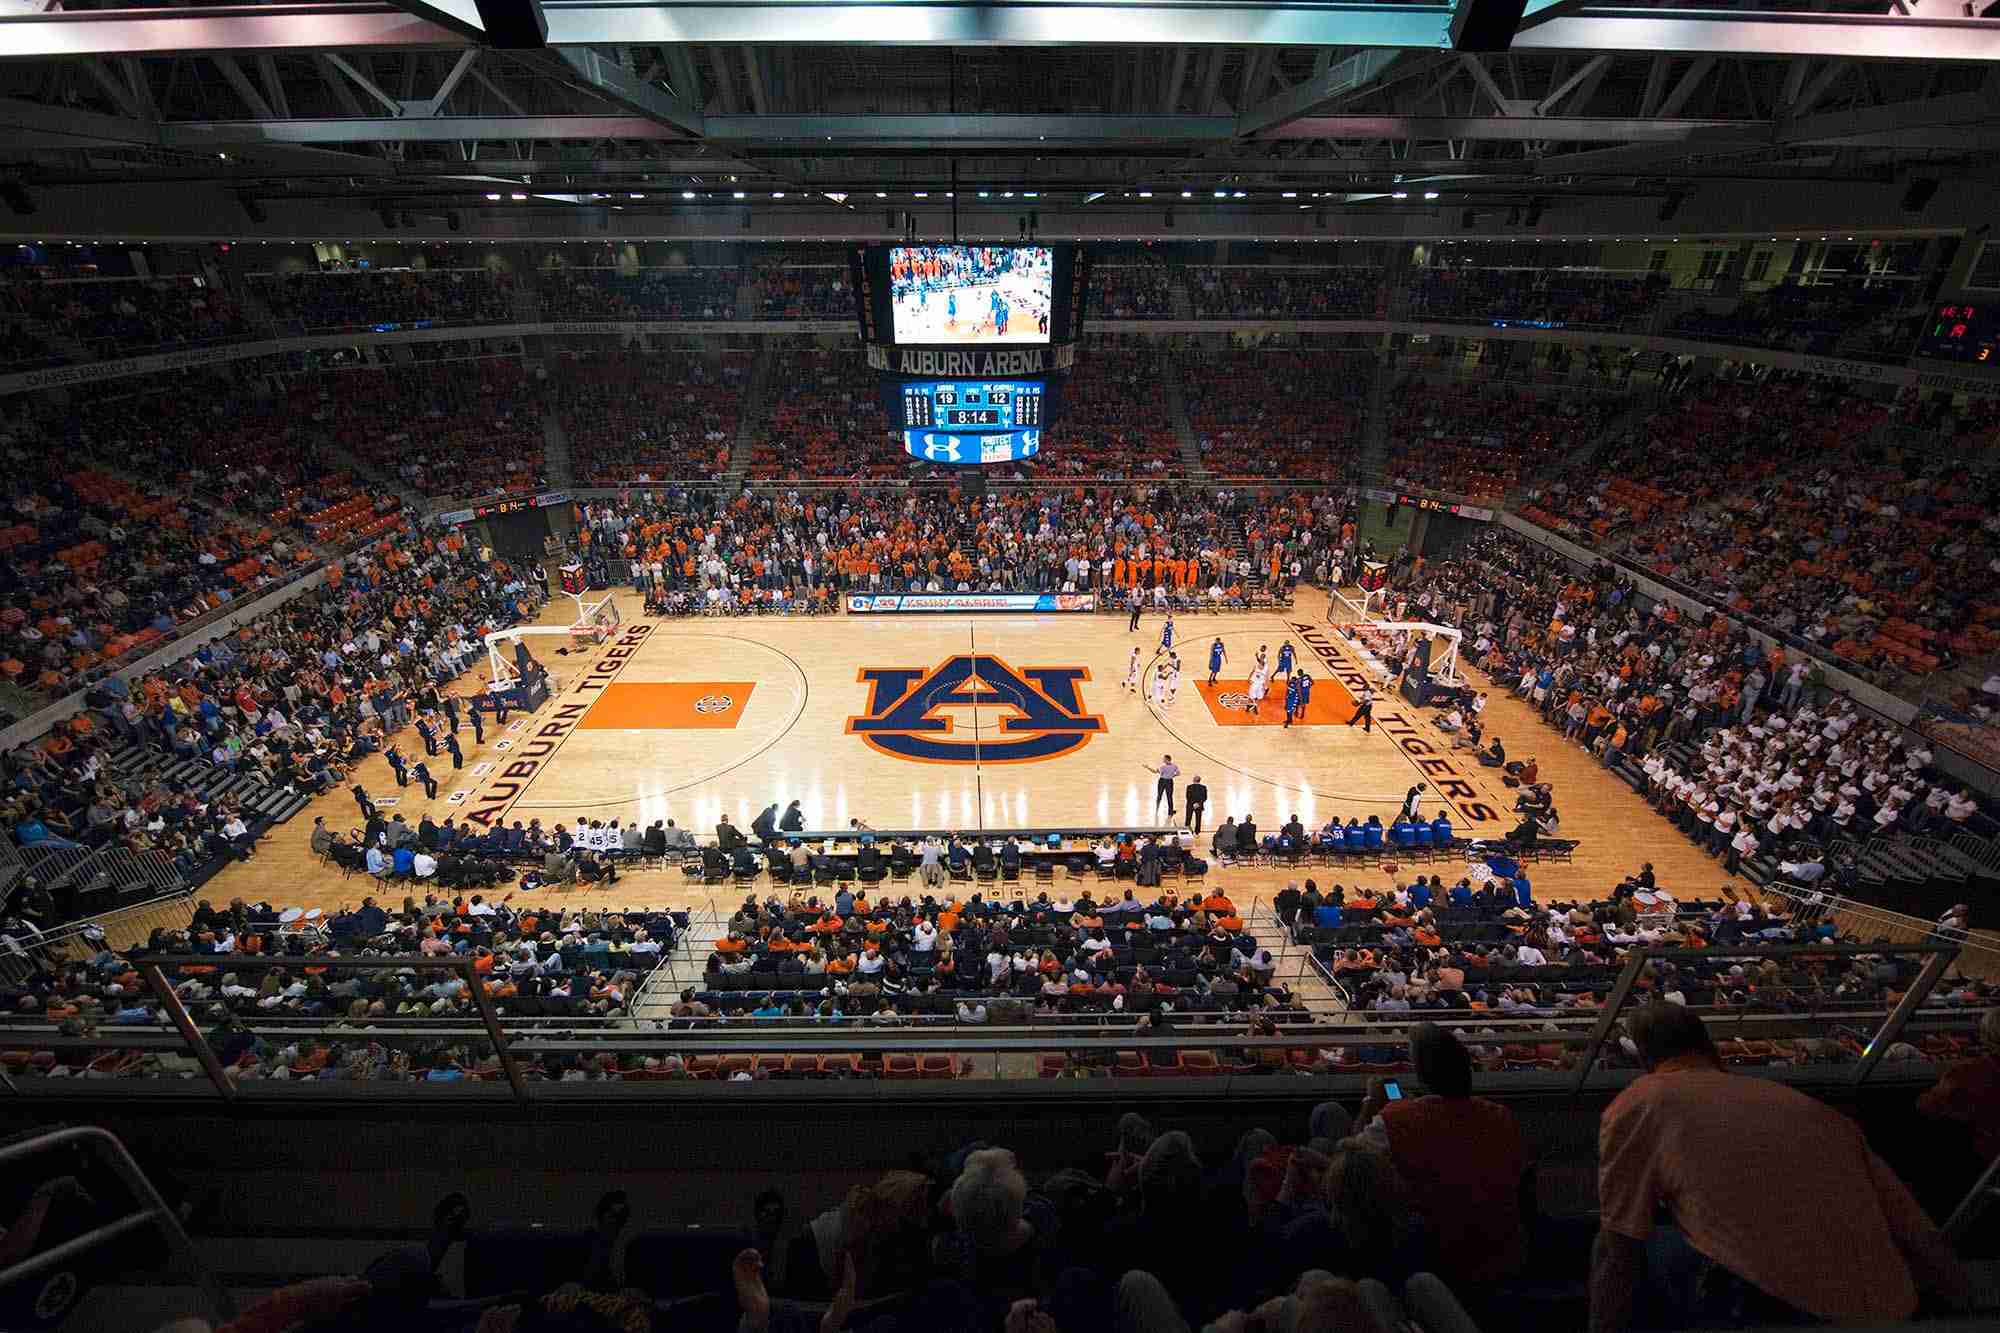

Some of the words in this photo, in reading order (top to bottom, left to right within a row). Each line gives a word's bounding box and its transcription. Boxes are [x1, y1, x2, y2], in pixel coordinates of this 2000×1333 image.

[900, 350, 976, 376] AUBURN
[982, 349, 1042, 376] ARENA
[939, 392, 953, 404] 19
[992, 393, 1006, 404] 12
[958, 410, 988, 424] 8:14
[466, 703, 589, 828] AUBURN
[576, 624, 652, 696] TIGERS
[1379, 712, 1501, 822] TIGERS
[578, 832, 585, 841] 2
